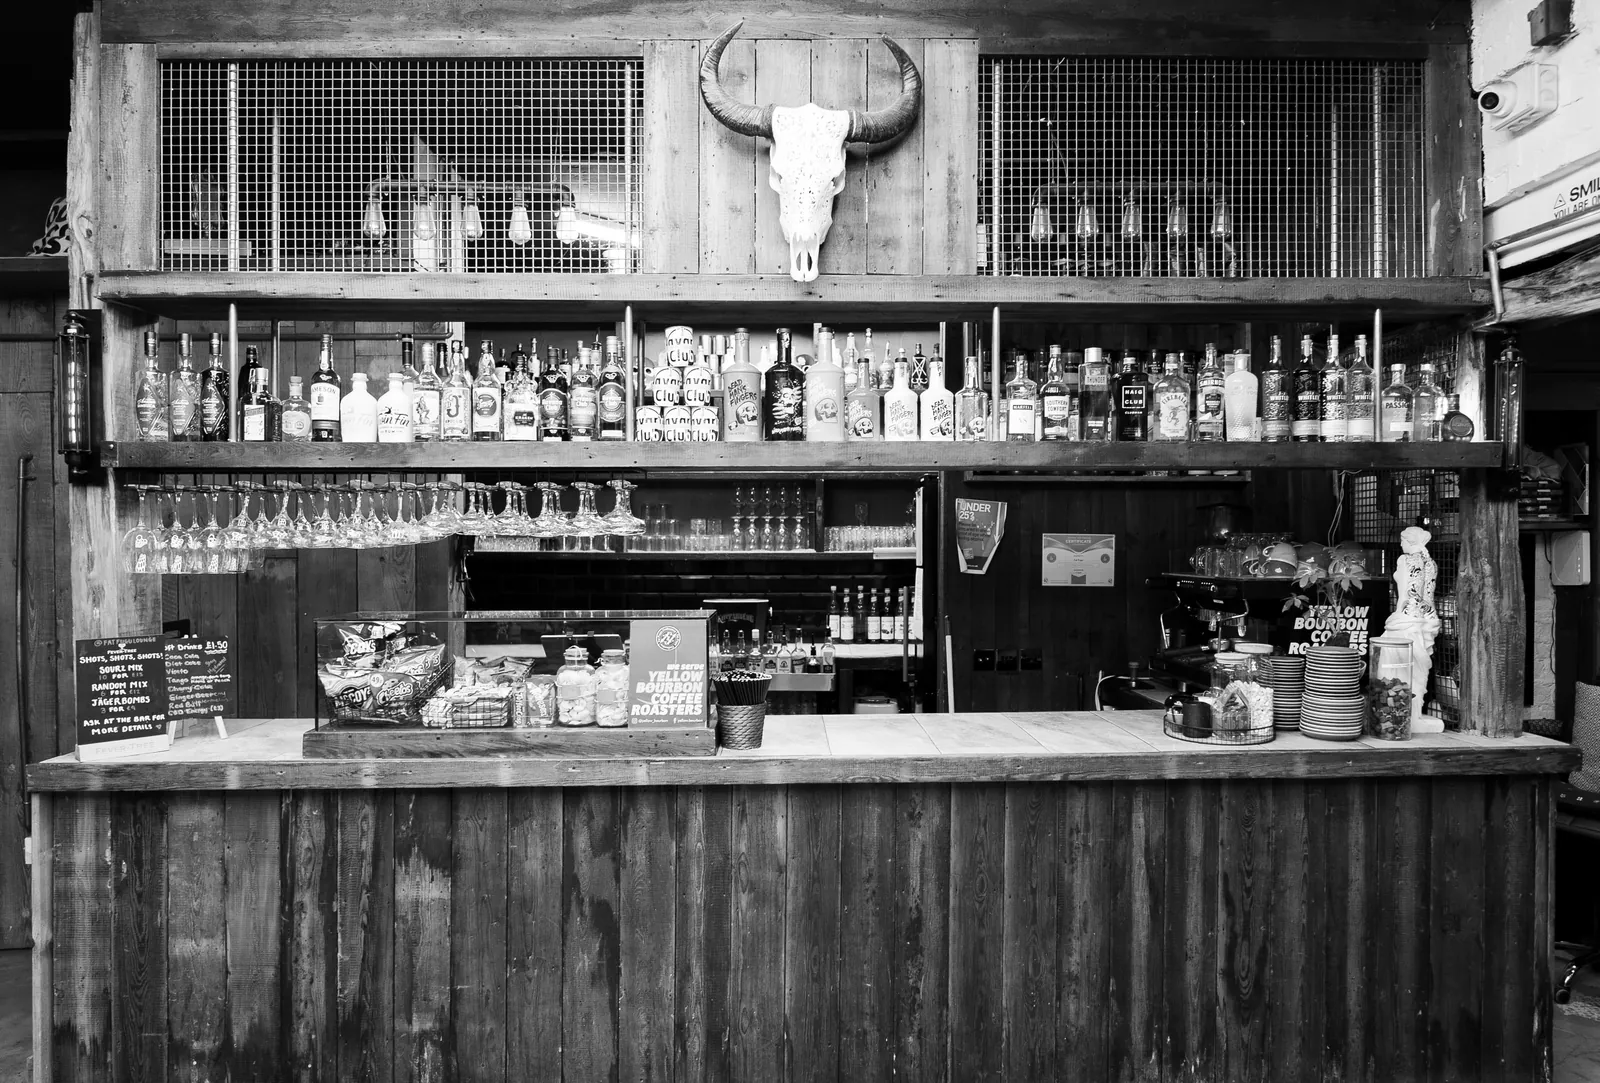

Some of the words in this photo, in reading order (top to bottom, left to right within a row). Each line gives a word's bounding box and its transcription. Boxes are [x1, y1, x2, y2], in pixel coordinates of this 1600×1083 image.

[311, 386, 336, 394] AMESON
[959, 501, 991, 513] UNDER
[1310, 630, 1368, 643] COEE
[178, 643, 203, 651] Drinks
[79, 656, 108, 664] SHOTS,
[127, 664, 143, 672] MIX
[166, 677, 189, 685] Tango
[648, 671, 704, 682] YELLOW
[91, 683, 126, 692] RANDOM
[636, 682, 703, 693] BOURBON
[376, 681, 413, 707] Cheetos
[651, 693, 703, 704] COFFEE
[91, 696, 150, 707] JÄGERBOMBS
[631, 704, 703, 716] ROASTERS
[84, 719, 100, 727] ASK
[91, 727, 118, 735] MORE
[122, 724, 153, 732] DETAILS
